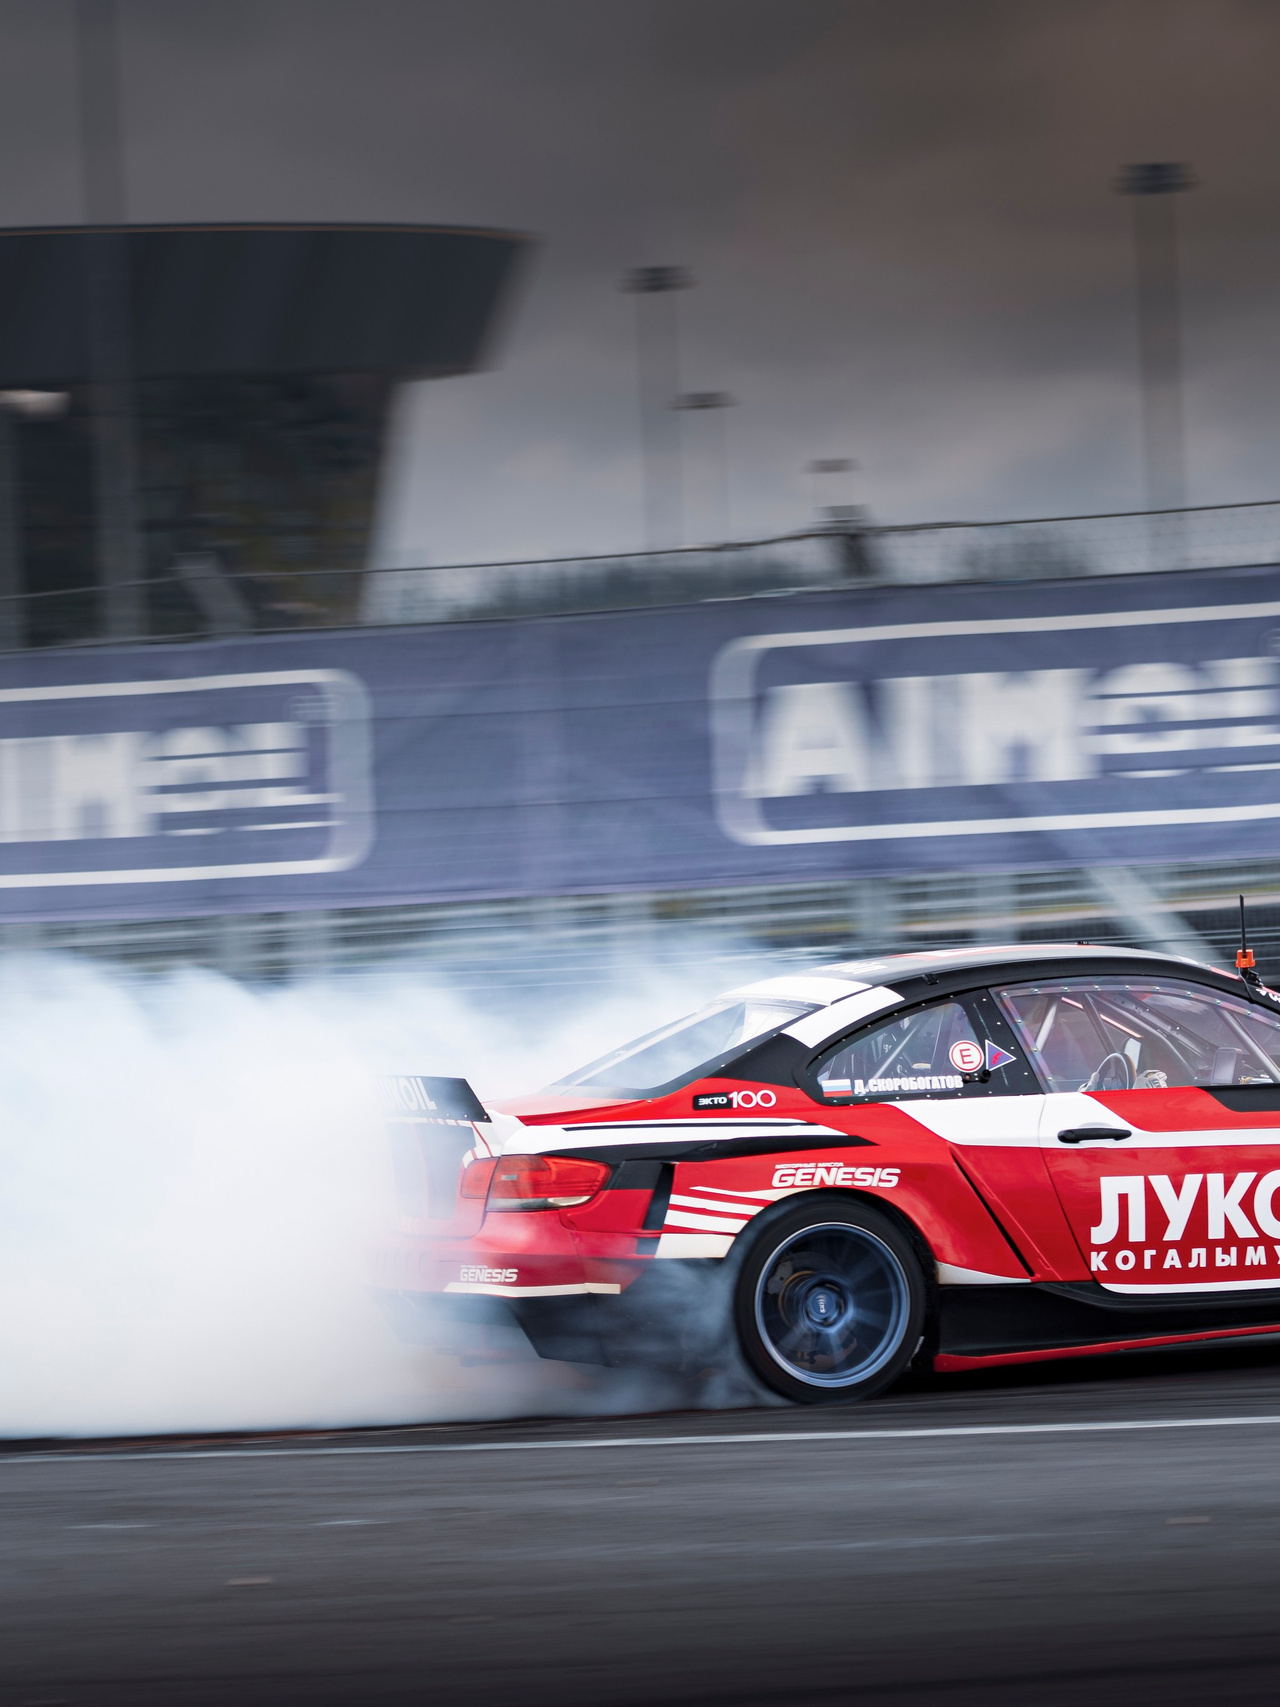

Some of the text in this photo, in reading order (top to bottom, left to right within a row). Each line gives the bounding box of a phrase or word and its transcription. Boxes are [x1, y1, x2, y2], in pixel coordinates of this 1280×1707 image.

[959, 1048, 975, 1065] E
[728, 1089, 777, 1108] 100
[771, 1167, 902, 1188] GENESIS
[460, 1268, 519, 1283] GENESIS
